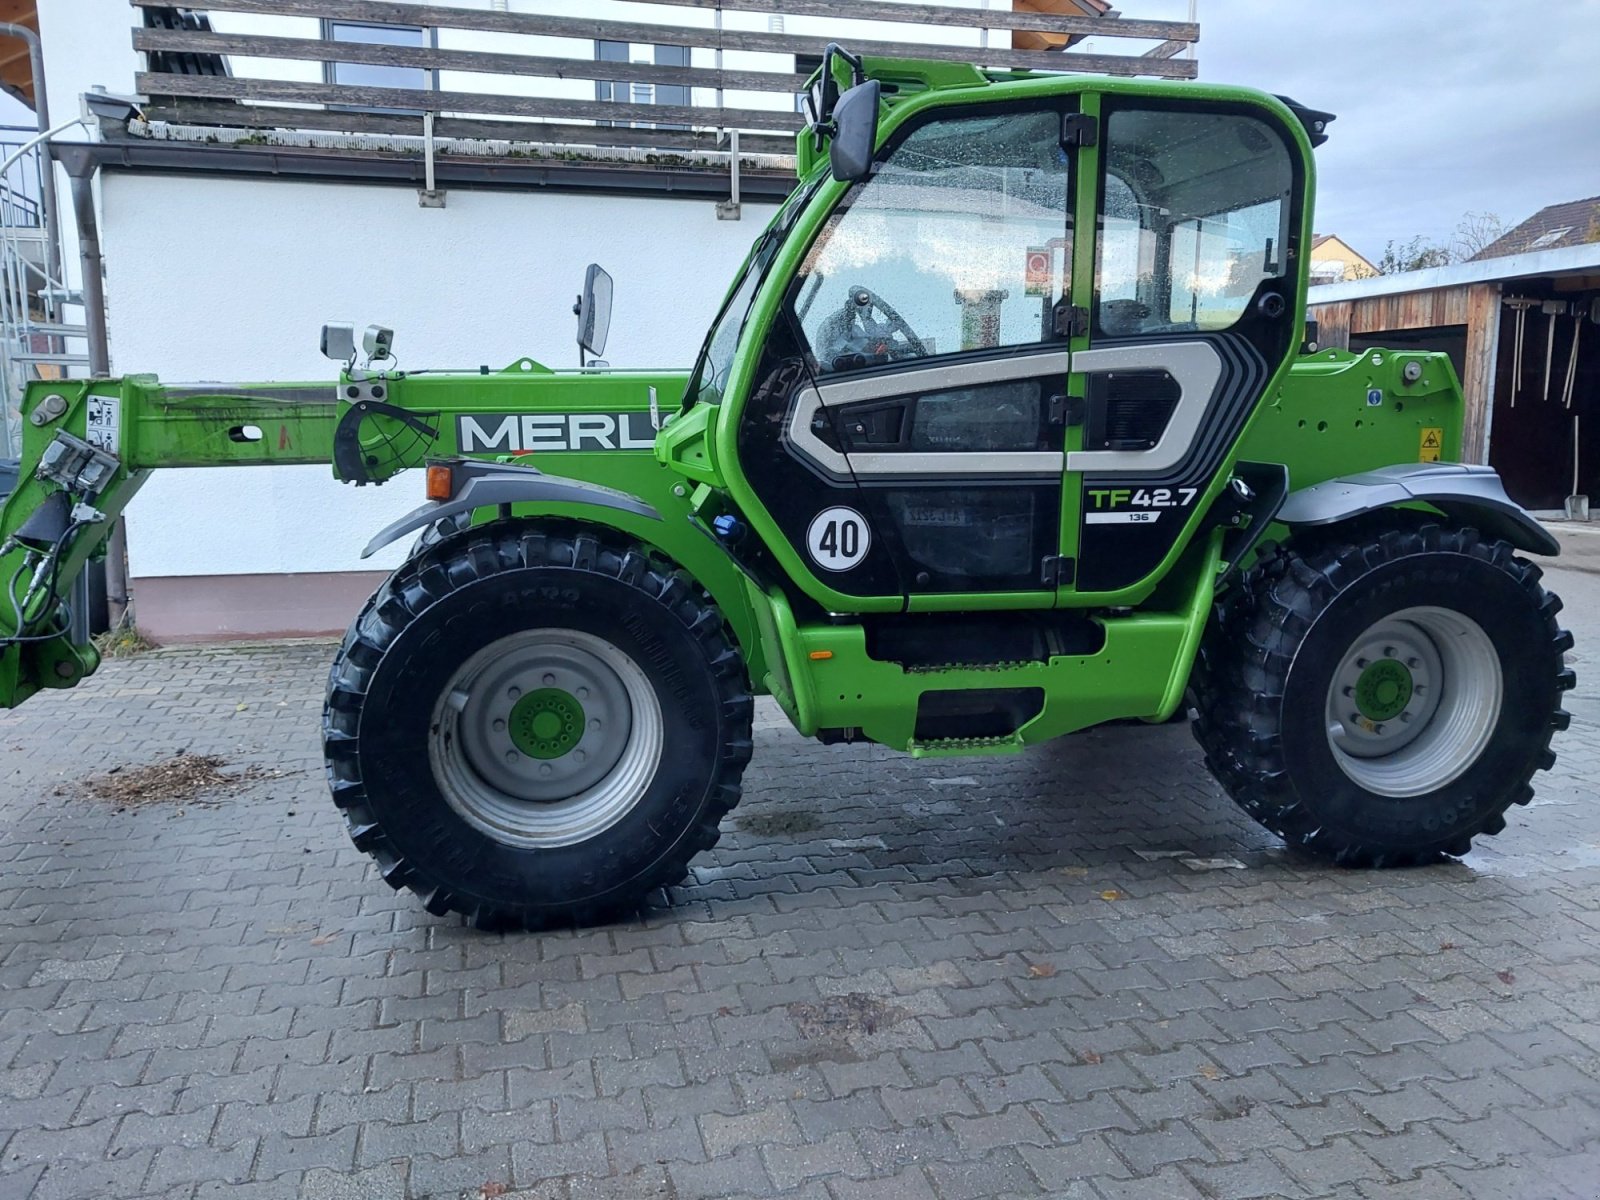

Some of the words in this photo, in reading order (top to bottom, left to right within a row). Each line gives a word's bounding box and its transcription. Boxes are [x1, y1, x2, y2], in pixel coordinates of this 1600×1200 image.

[460, 414, 676, 452] MERL
[1088, 488, 1197, 508] TF42.7
[819, 520, 858, 558] 40
